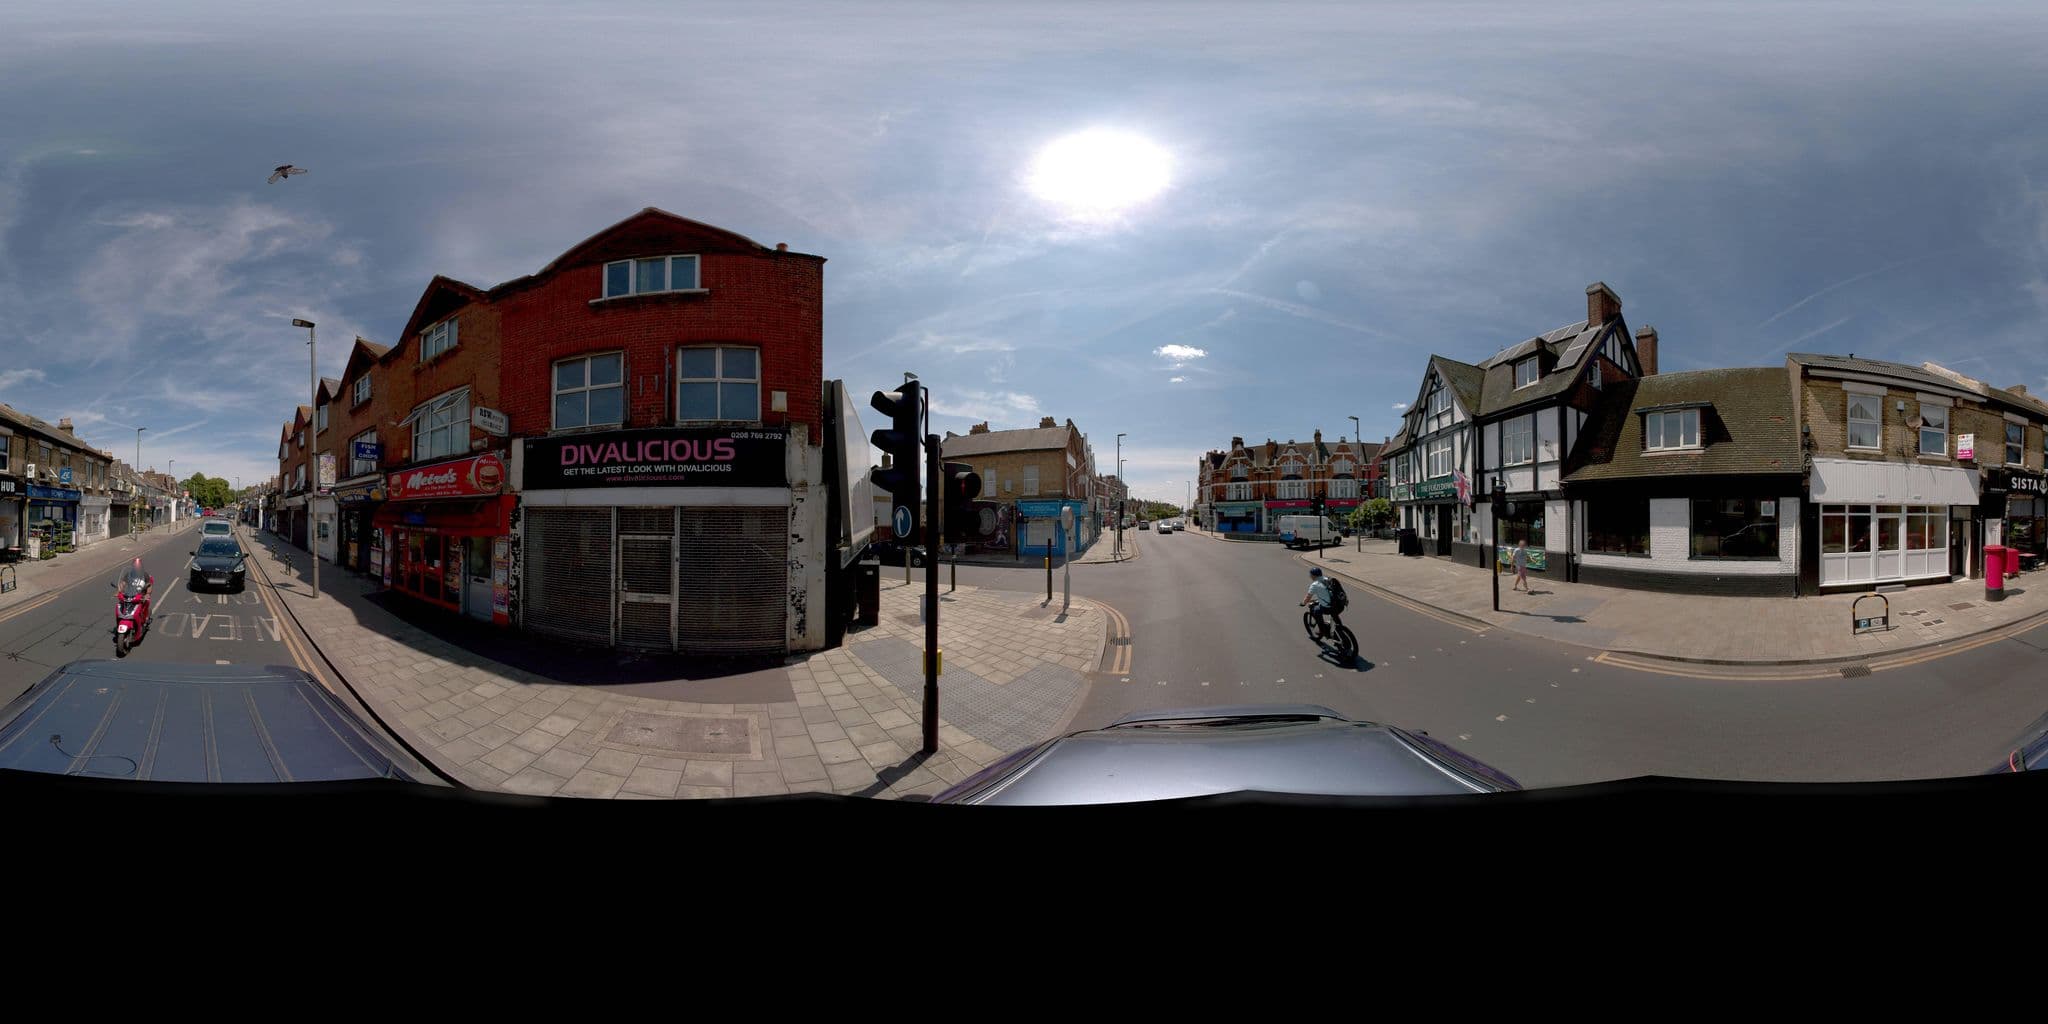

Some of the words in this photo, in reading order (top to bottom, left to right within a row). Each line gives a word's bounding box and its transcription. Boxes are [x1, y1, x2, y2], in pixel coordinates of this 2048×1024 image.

[730, 431, 748, 439] 0208
[764, 432, 783, 440] 2792
[560, 438, 736, 466] DIVALICIOUS
[563, 467, 578, 476] GET
[580, 467, 595, 475] THE
[597, 466, 626, 475] LATEST
[628, 465, 652, 473] LOOK
[654, 464, 675, 473] WITH
[677, 464, 732, 473] DIVALICIOUS
[0, 481, 15, 492] HUB
[2011, 477, 2038, 490] SISTA
